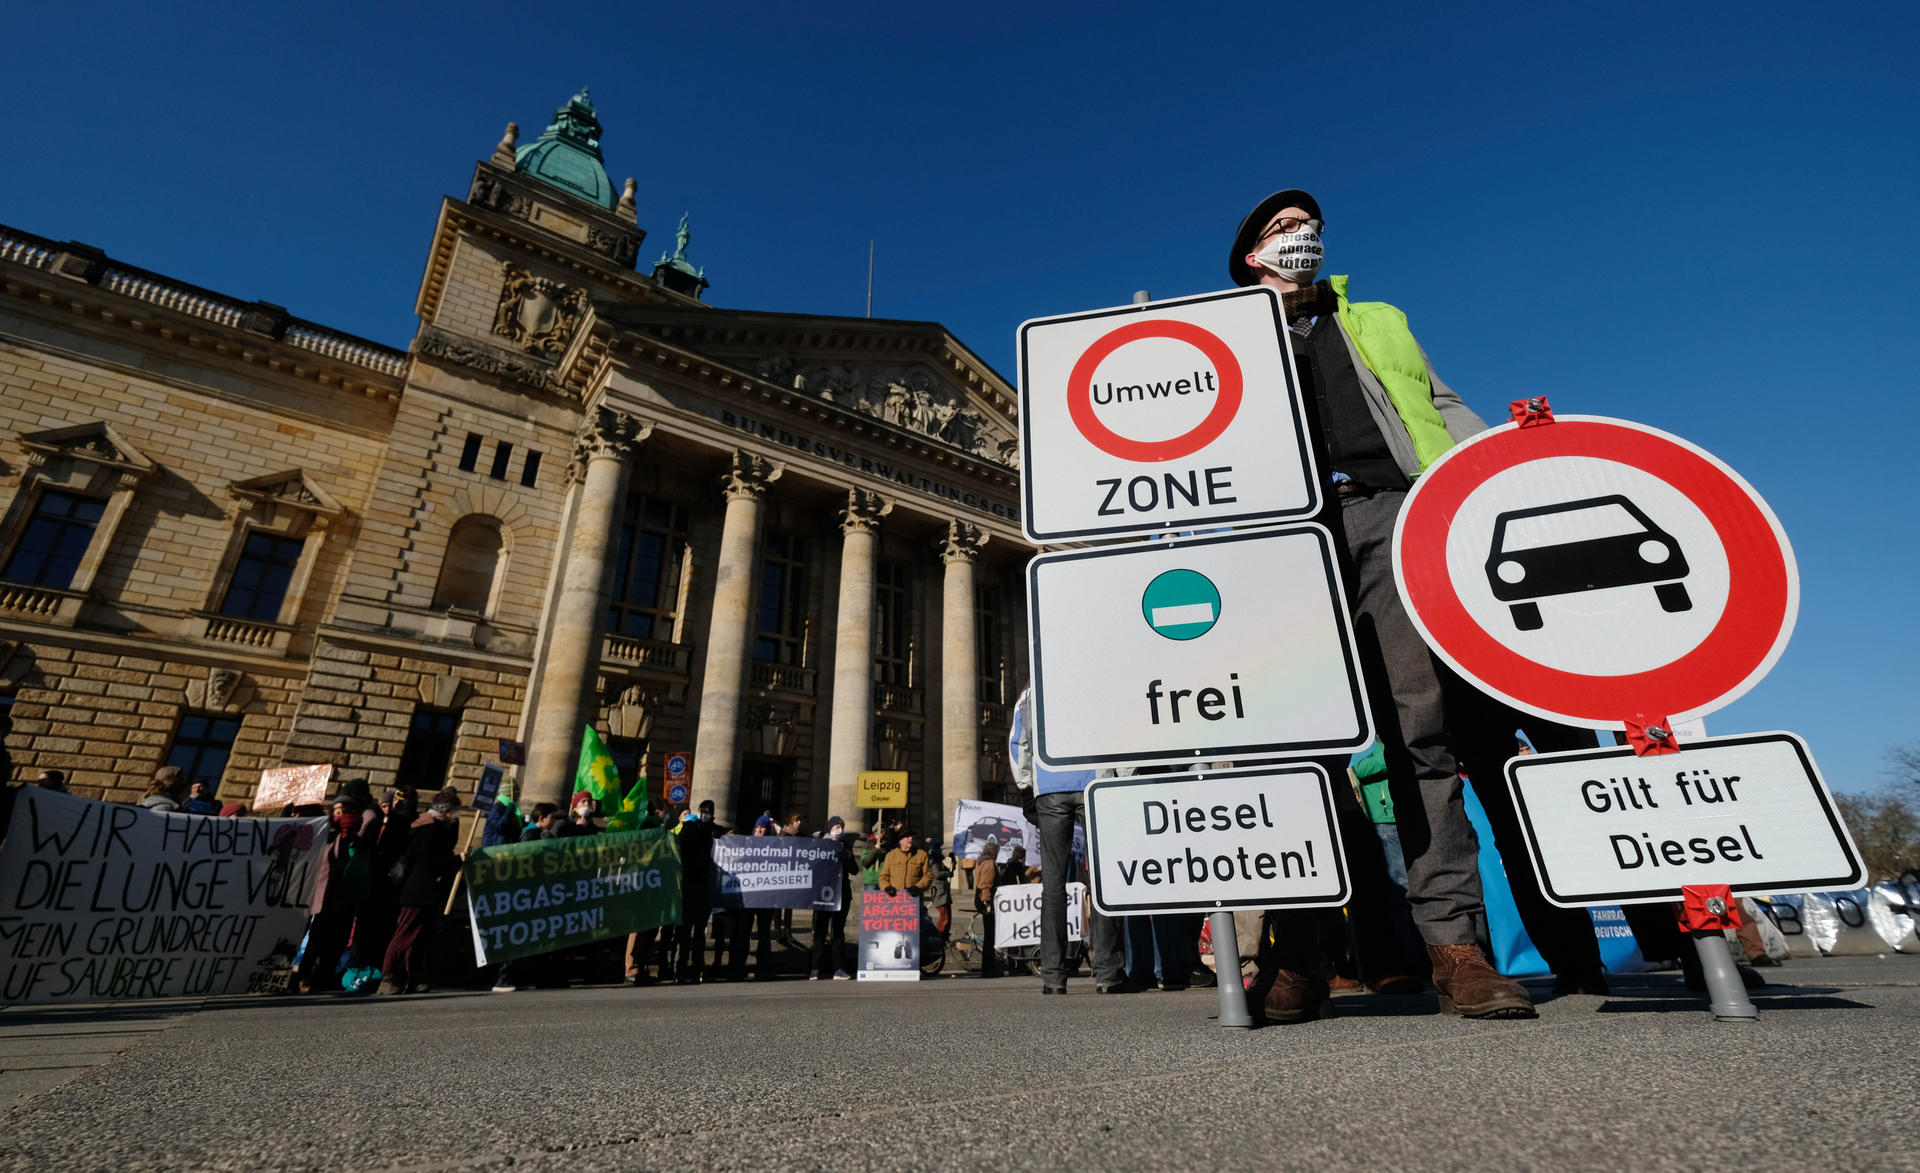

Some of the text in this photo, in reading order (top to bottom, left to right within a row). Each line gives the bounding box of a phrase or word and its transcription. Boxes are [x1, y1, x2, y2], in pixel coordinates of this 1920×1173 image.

[1092, 370, 1216, 405] Umwelt
[1096, 466, 1237, 517] ZONE
[1145, 673, 1245, 726] frei
[863, 779, 901, 793] Leipzig
[1581, 769, 1741, 813] Gilt für
[29, 797, 270, 858] WIR HABEN
[1143, 794, 1274, 836] Diesel
[719, 845, 838, 862] Tausendmal regiert,
[1117, 840, 1319, 887] verboten!
[1609, 825, 1763, 870] Diesel
[15, 858, 311, 912] DIE LUNGE VOLL
[473, 852, 535, 886] FÜR
[474, 869, 662, 919] ABGAS-BETRUG
[863, 904, 917, 917] ABGASE
[87, 915, 265, 955] GRUNDRECHT
[1013, 916, 1080, 939] lebn!
[51, 957, 182, 998] SAUBERE
[182, 956, 248, 995] LUFT
